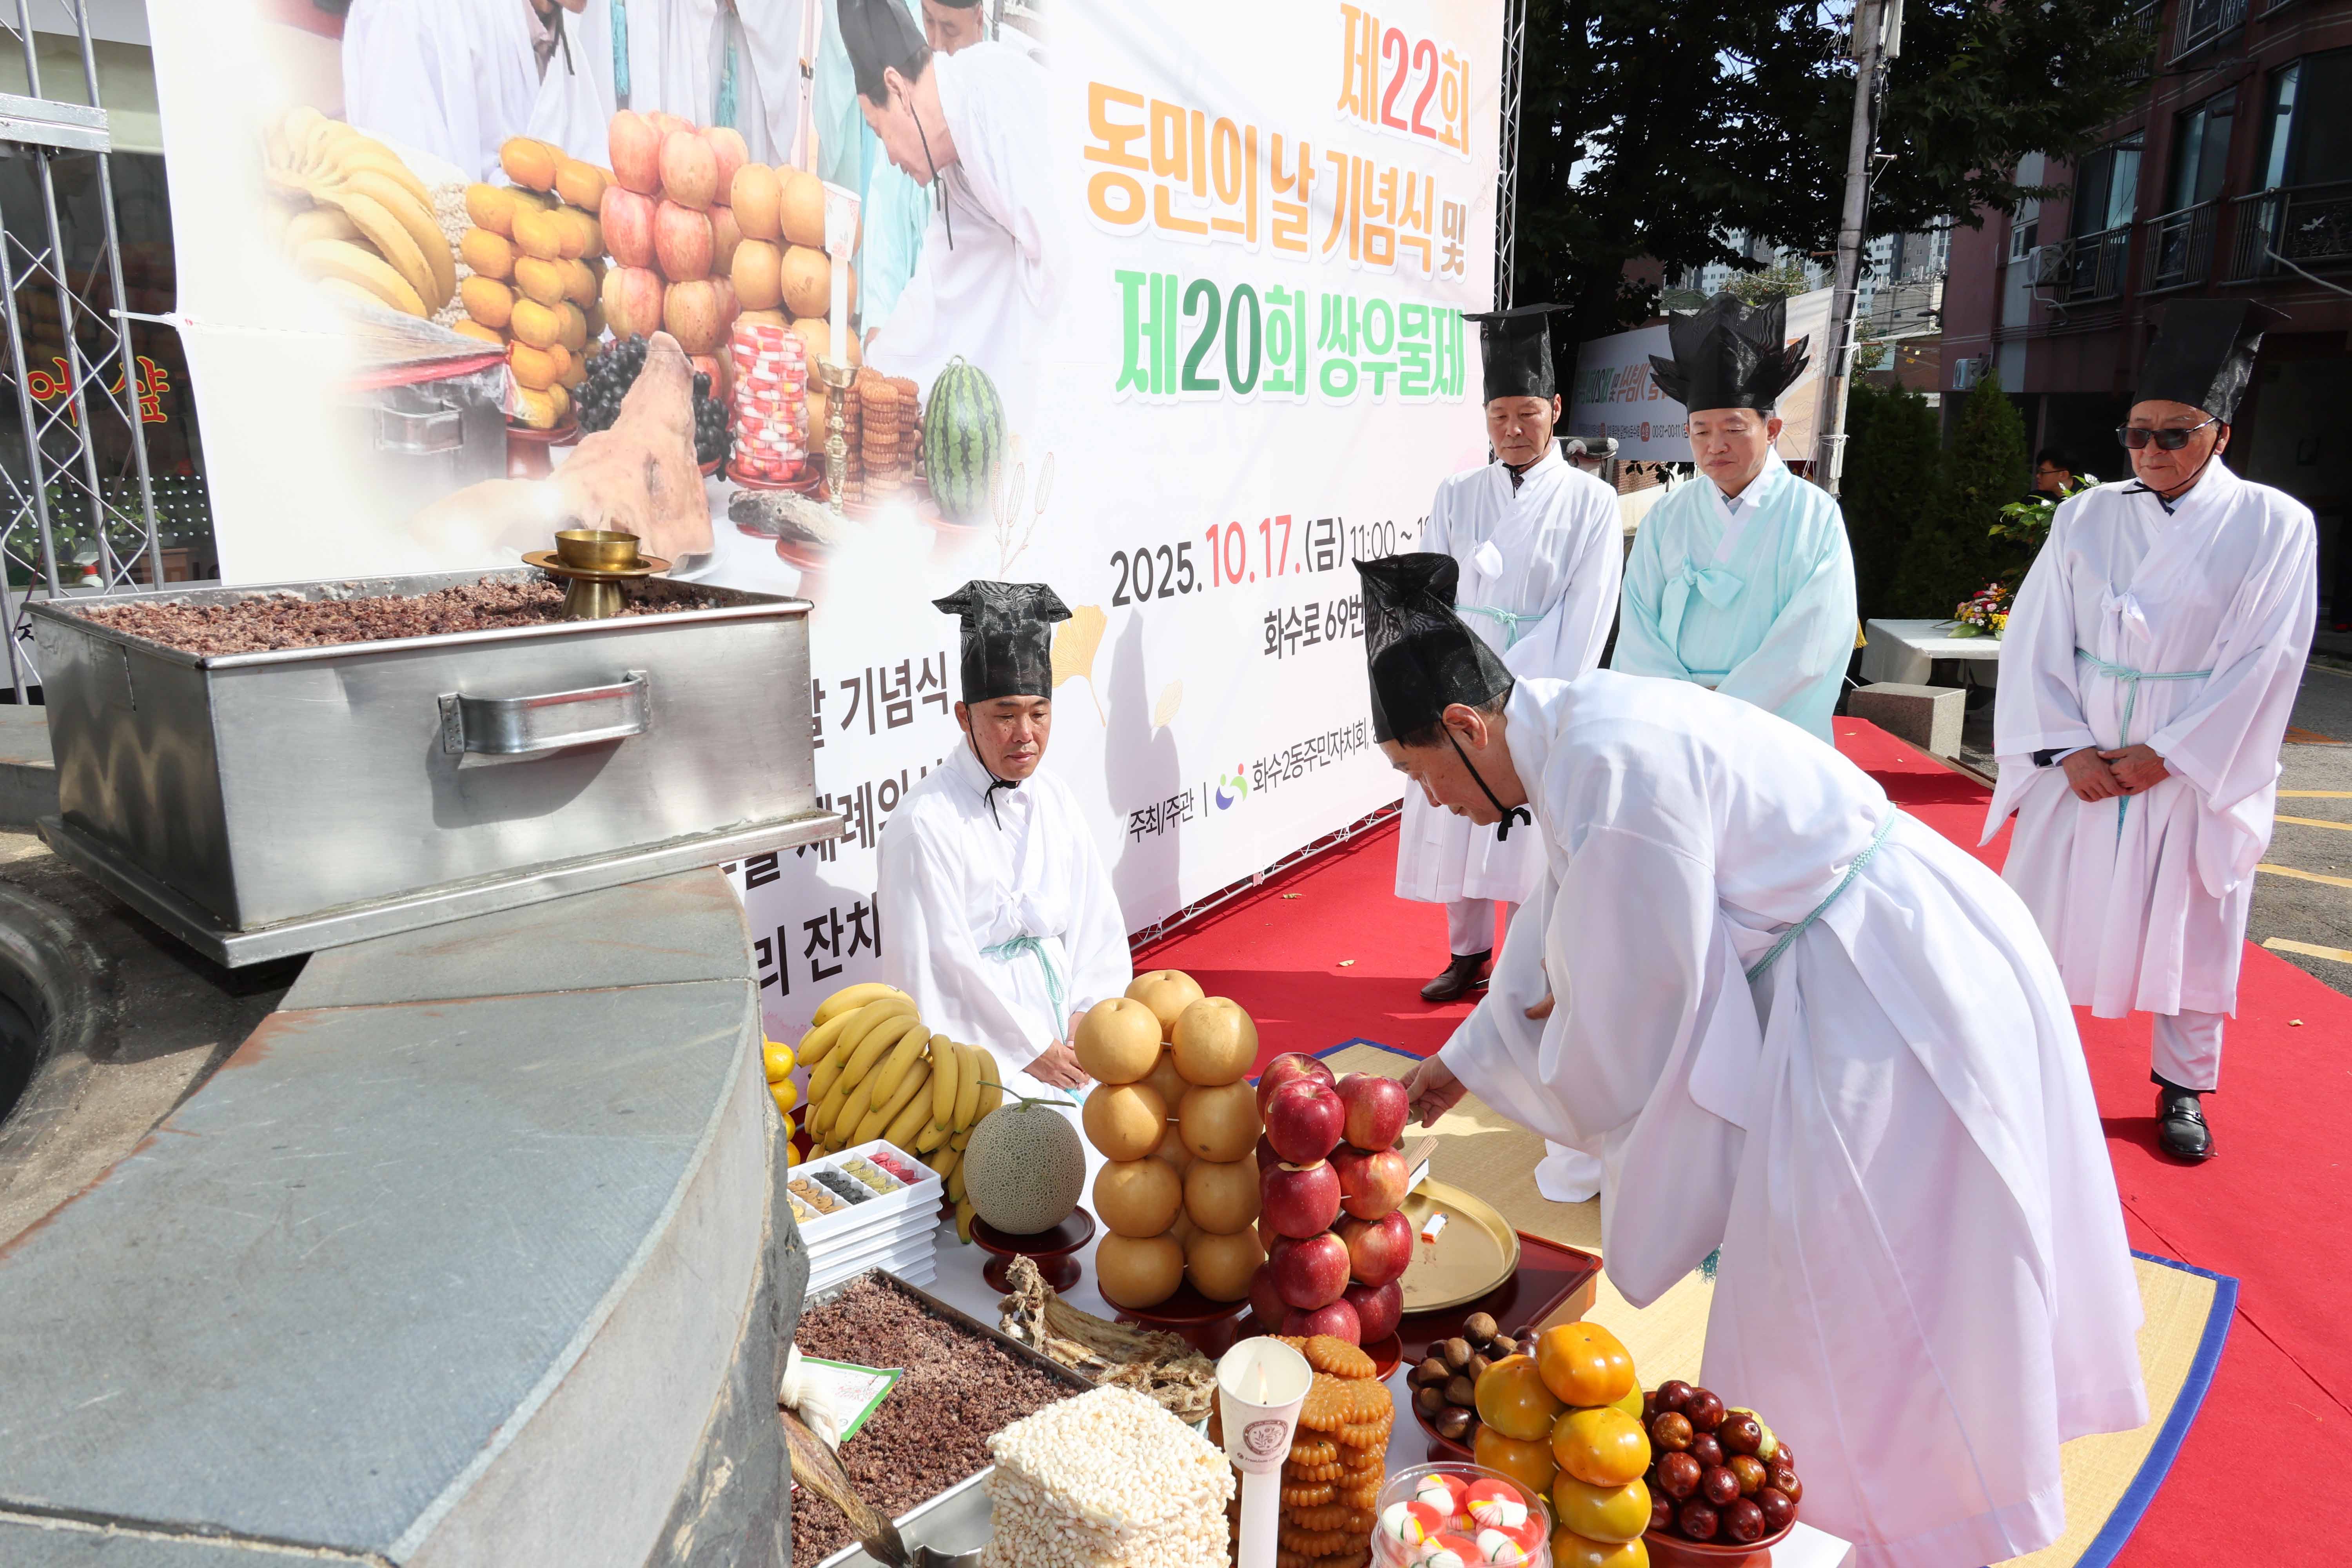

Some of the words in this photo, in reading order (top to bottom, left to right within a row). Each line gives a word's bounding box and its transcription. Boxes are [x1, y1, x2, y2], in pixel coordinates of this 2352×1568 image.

[1337, 3, 1469, 155] 제22회
[1084, 81, 1257, 243] 동민의
[1270, 132, 1315, 253] 날
[1322, 149, 1434, 272] 기념식
[1441, 198, 1466, 276] 및
[1114, 269, 1306, 395] 제20회
[1317, 292, 1464, 397] 쌍우물제
[1350, 520, 1395, 563] 11:00
[1264, 603, 1321, 659] 화수로
[840, 651, 949, 735] 기념식
[1130, 788, 1194, 843] 주최/주관
[1252, 717, 1369, 793] 화수2동주민자치회,
[803, 891, 882, 982] 잔치
